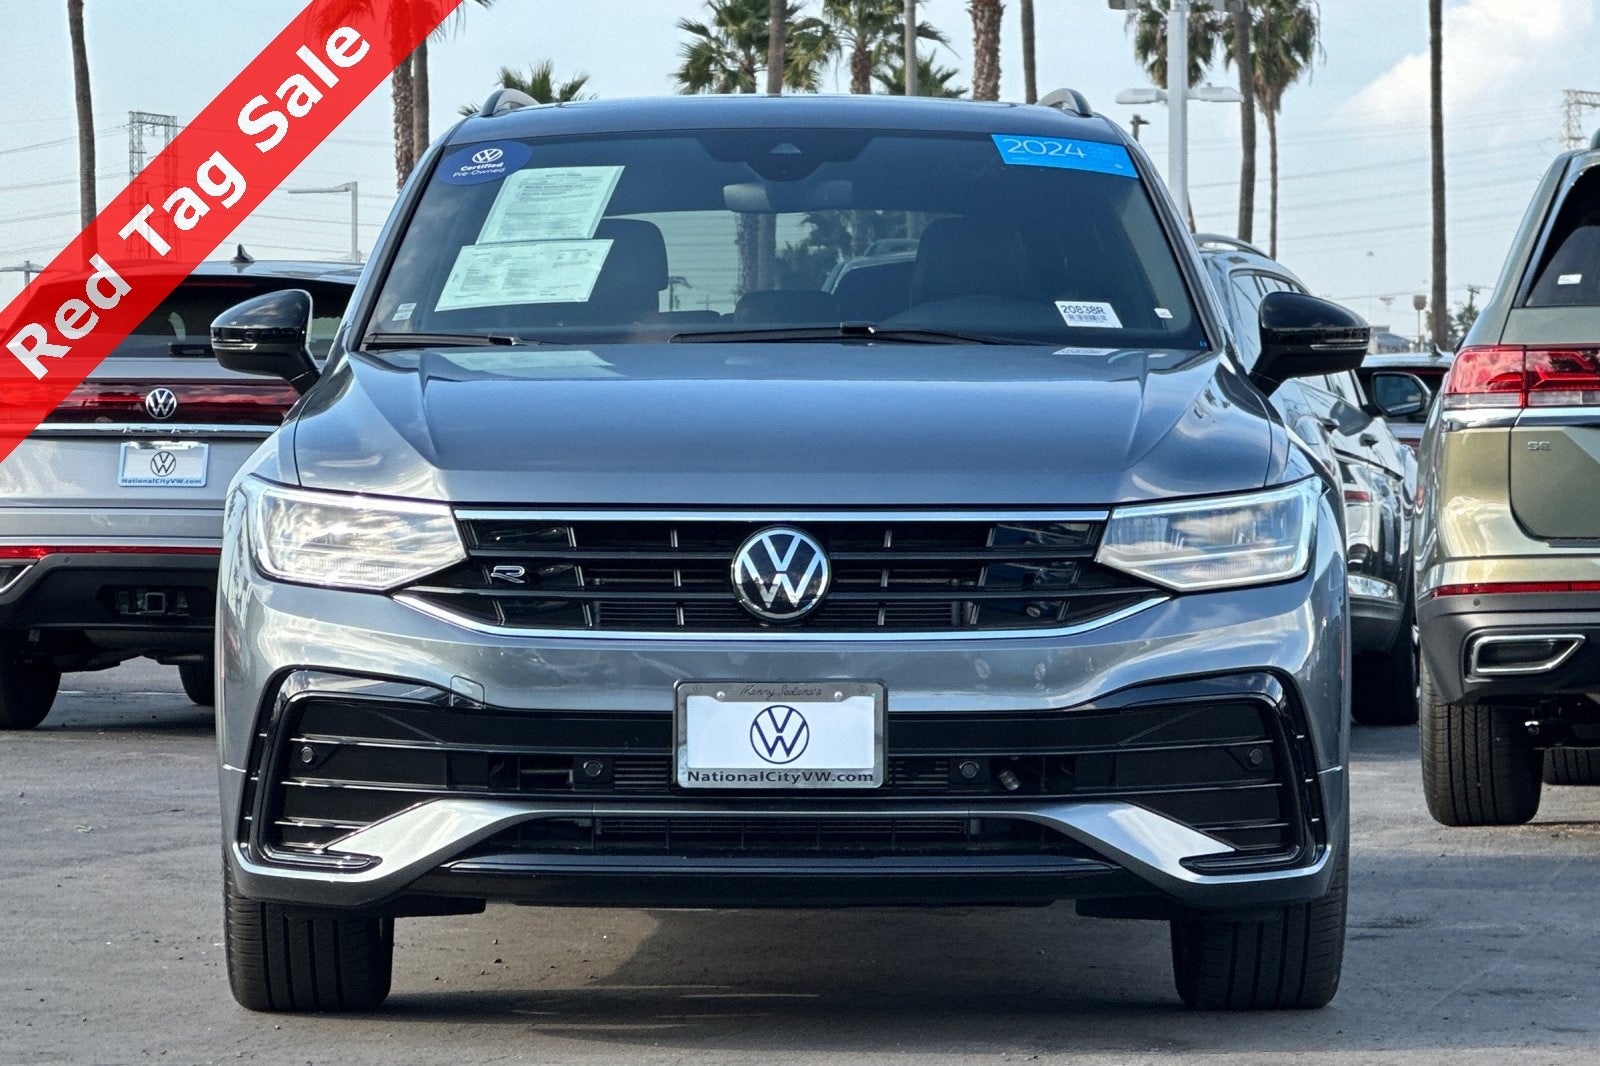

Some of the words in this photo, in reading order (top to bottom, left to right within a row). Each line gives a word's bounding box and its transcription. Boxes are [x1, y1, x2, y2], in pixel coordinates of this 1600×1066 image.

[1002, 138, 1087, 159] 2024
[460, 162, 505, 171] Certified
[452, 167, 506, 178] Pre-Owned
[1060, 305, 1106, 315] 20838R
[687, 770, 874, 785] NationalCityVW.com
